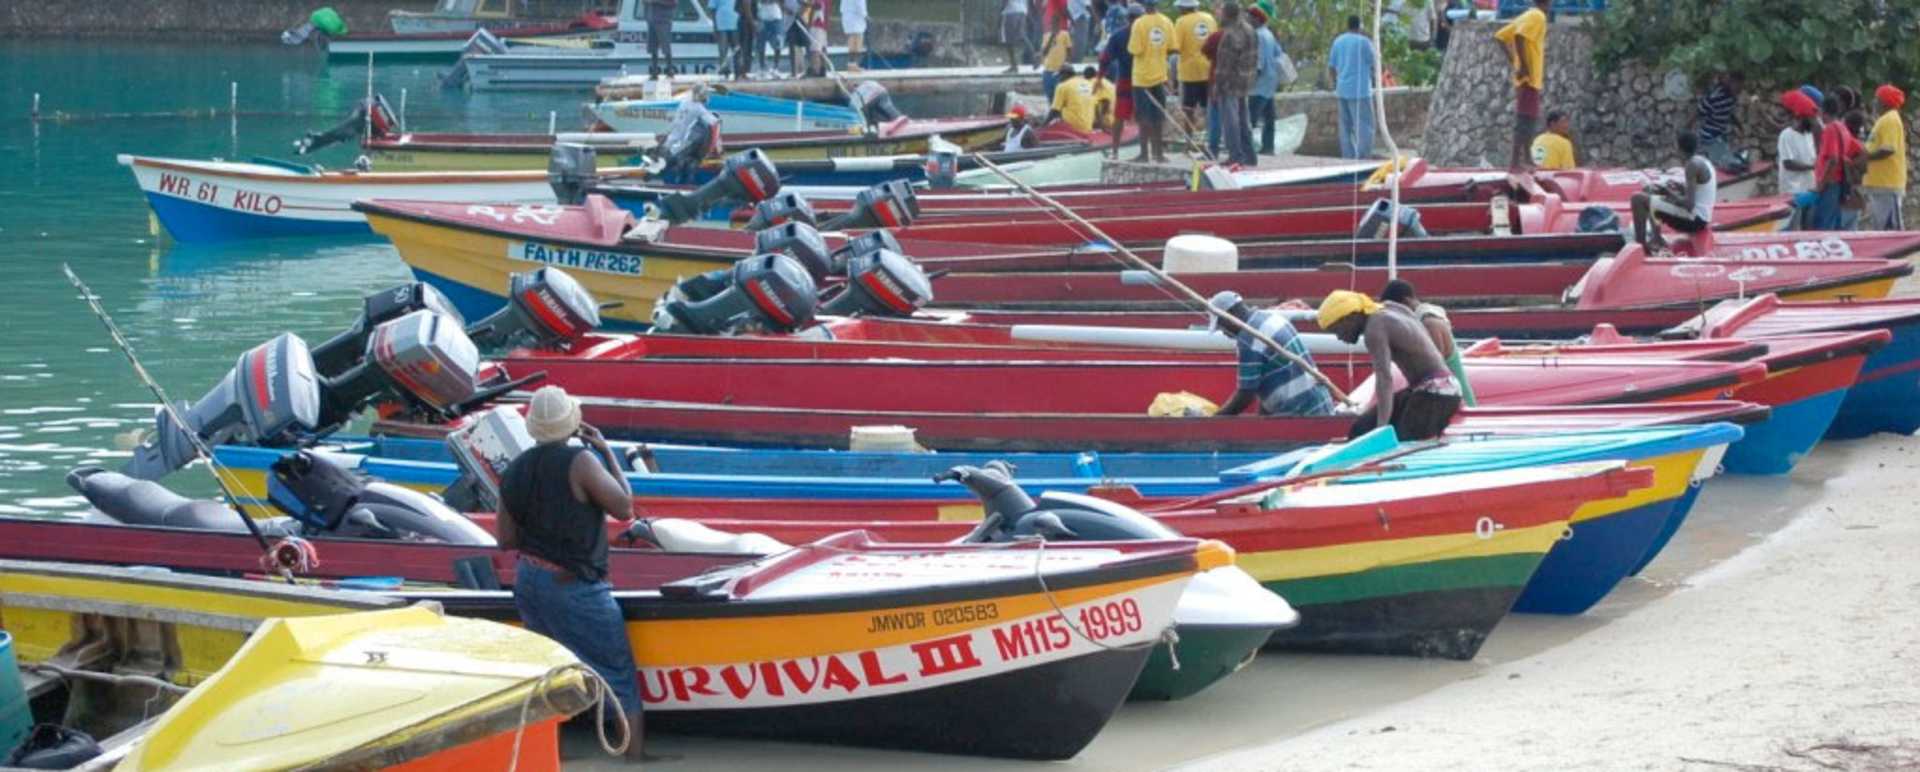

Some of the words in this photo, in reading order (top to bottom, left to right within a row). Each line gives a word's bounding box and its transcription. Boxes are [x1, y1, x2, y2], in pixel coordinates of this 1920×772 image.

[233, 189, 283, 215] KILO
[523, 242, 581, 267] FAITH
[933, 602, 999, 626] 020583
[635, 650, 908, 704] URVIVAL
[911, 633, 982, 678] III
[992, 614, 1071, 661] M115
[1079, 597, 1142, 641] 1999
